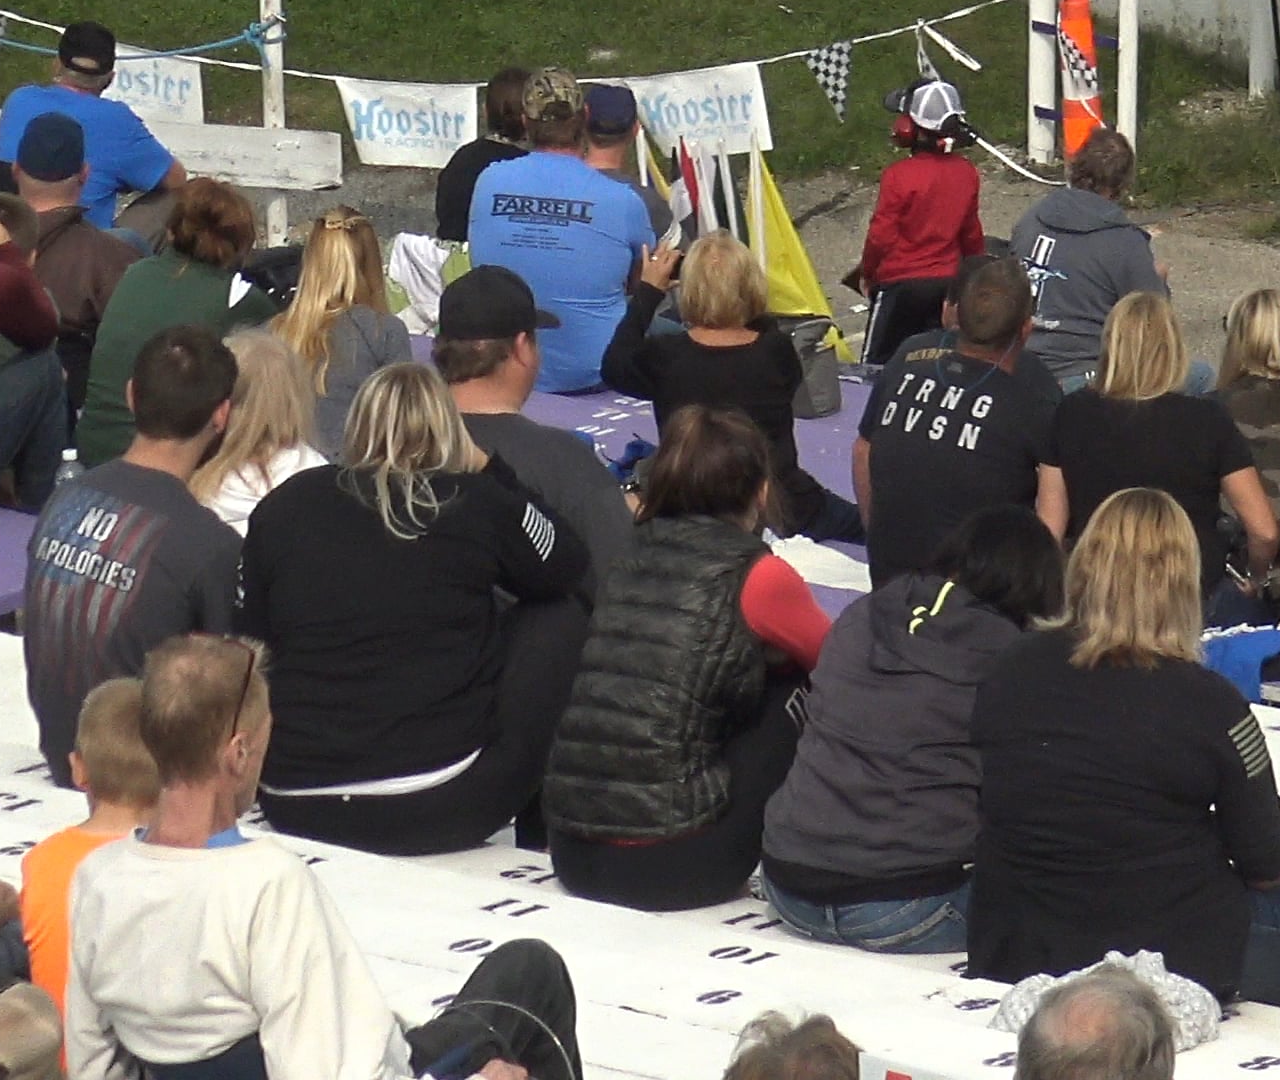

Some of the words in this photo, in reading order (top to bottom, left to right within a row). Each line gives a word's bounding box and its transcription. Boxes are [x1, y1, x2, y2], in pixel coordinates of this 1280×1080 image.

[350, 96, 466, 142] Hoosier
[639, 83, 754, 134] Hoosier
[491, 194, 594, 223] FARRELL
[896, 373, 994, 419] TRNG
[880, 401, 982, 451] DVSN
[76, 506, 119, 543] NO
[35, 536, 137, 593] APOLOGIES
[479, 898, 550, 918] 11
[708, 945, 780, 965] 10
